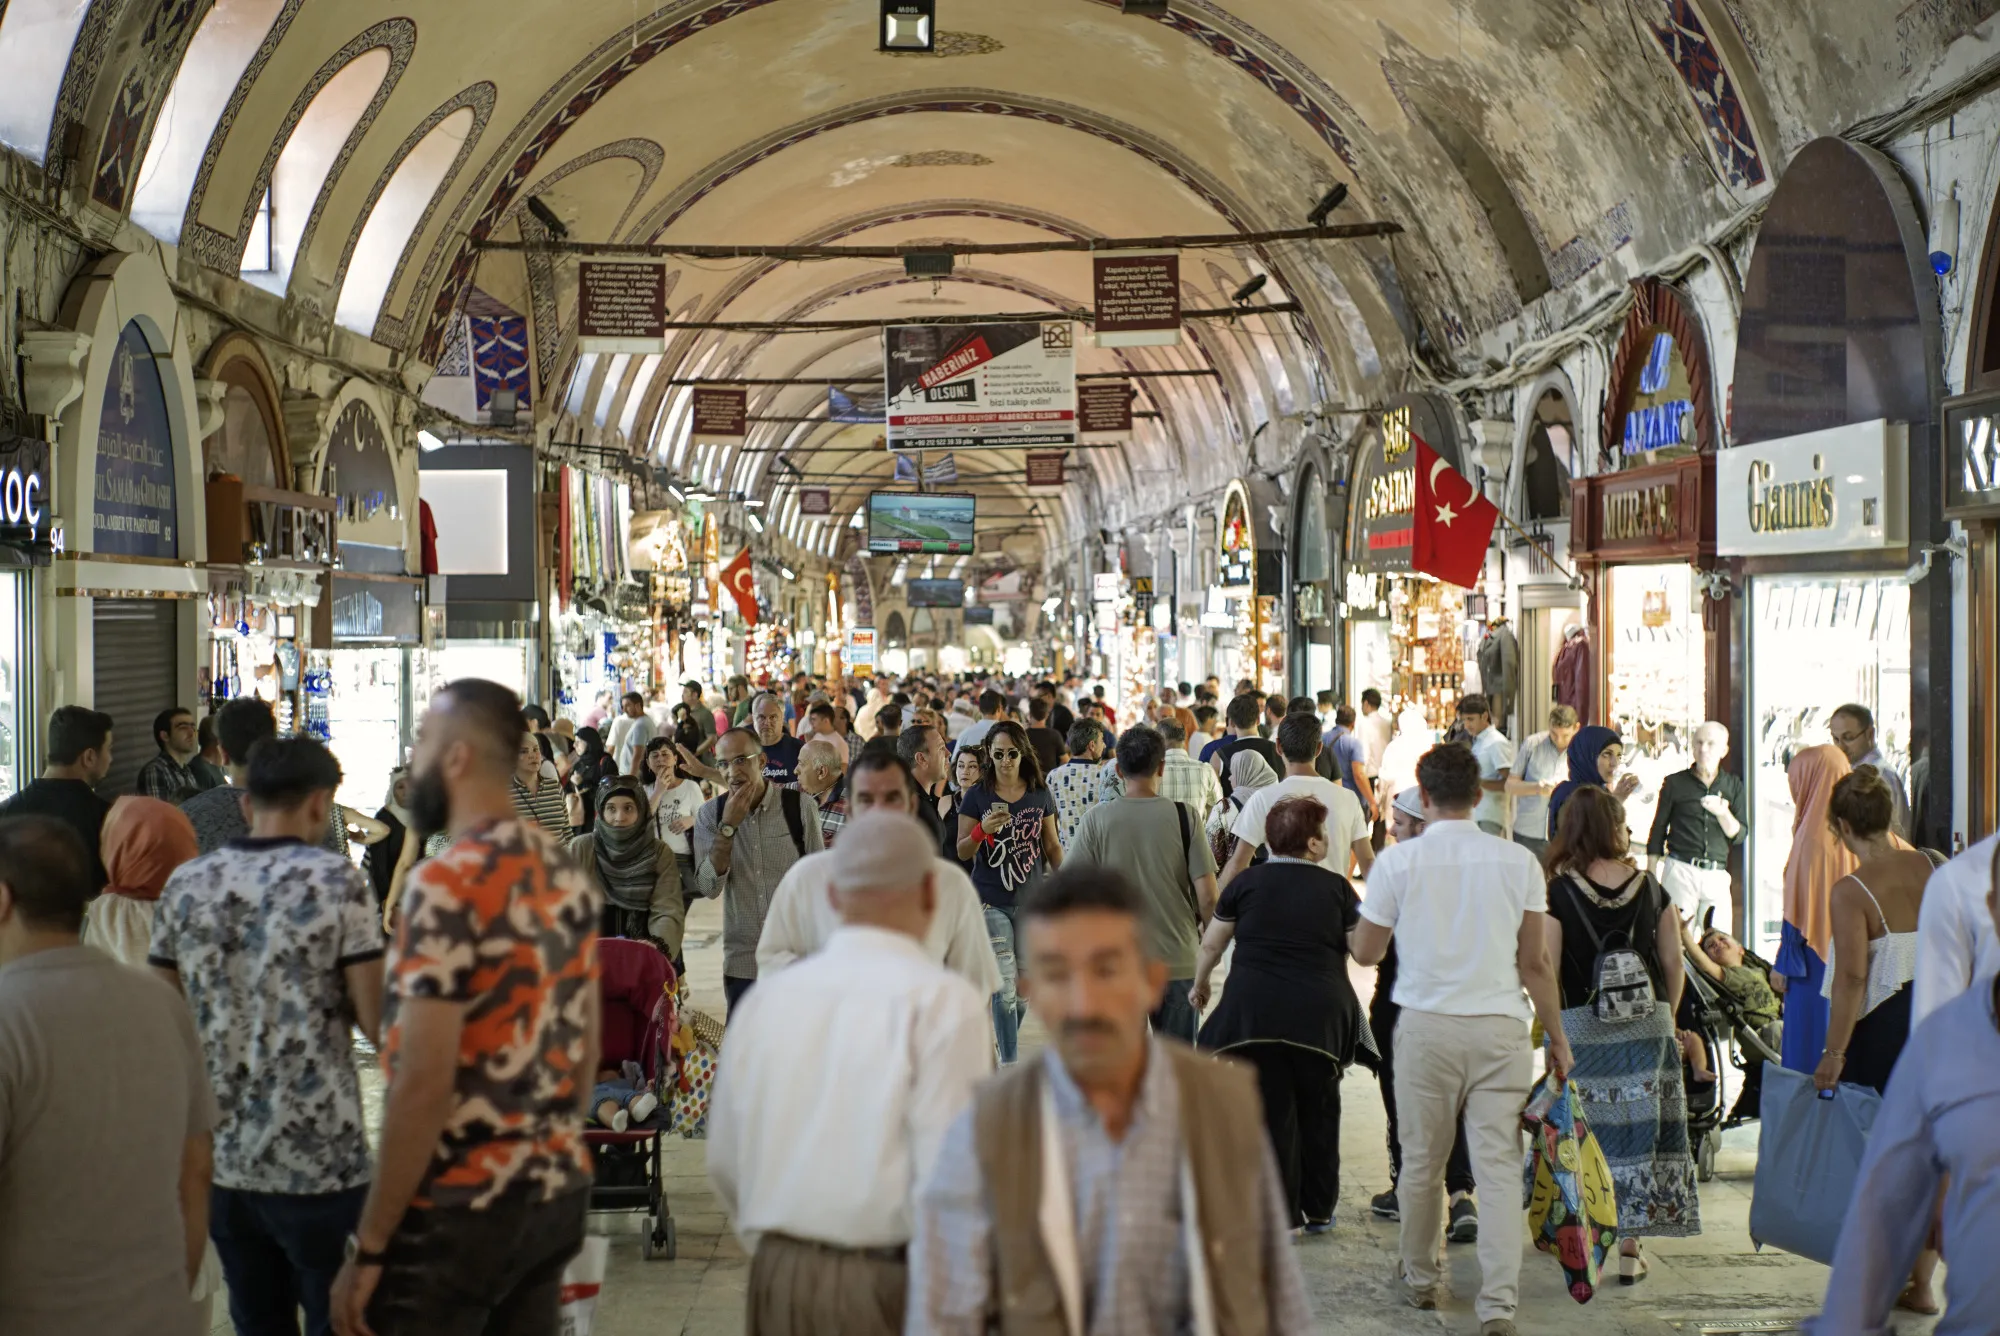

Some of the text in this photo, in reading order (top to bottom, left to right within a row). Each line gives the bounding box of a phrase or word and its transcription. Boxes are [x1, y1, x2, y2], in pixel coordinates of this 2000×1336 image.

[922, 348, 980, 387] HABERİNİZ
[929, 384, 968, 401] OLSUN!
[1007, 398, 1028, 406] takip
[1030, 397, 1051, 405] edin!
[904, 411, 1061, 425] ÇARŞIMIZDA NELER OLUYOR? HABERİNİZ OLSUN!
[1748, 453, 1834, 533] Giannis
[0, 468, 40, 541] OÇ
[50, 527, 64, 554] 94
[761, 767, 788, 778] Cooper
